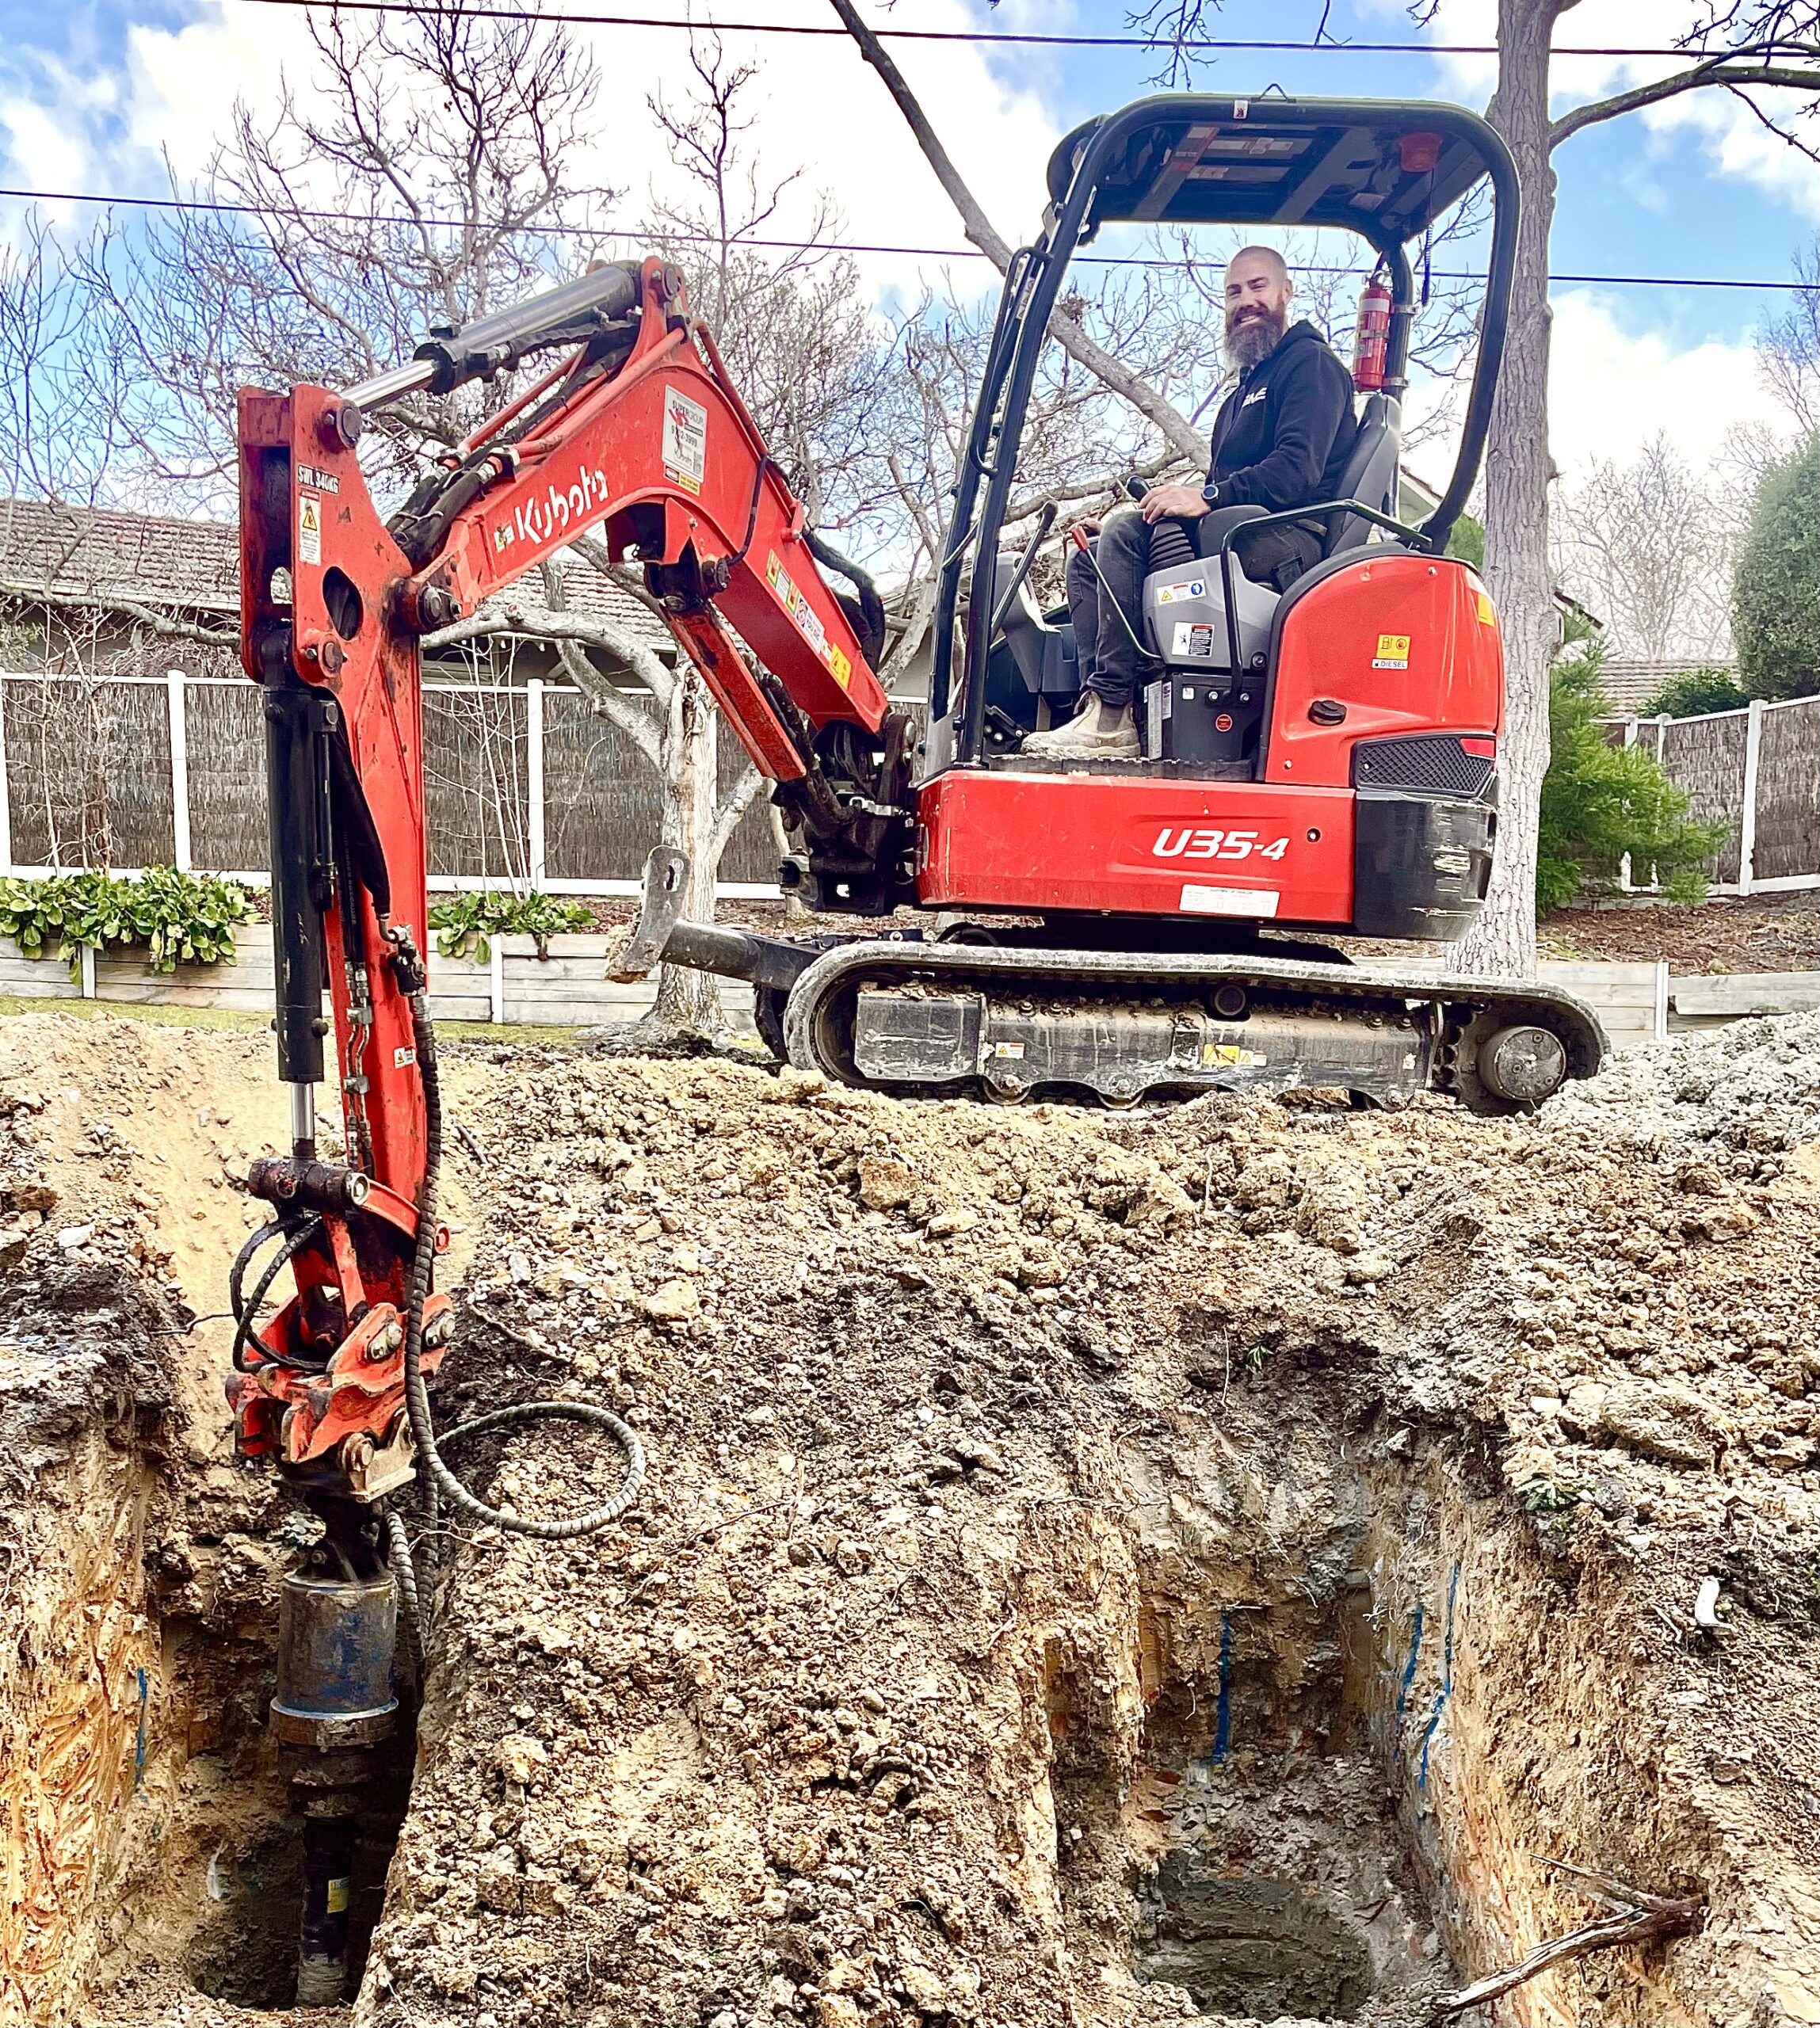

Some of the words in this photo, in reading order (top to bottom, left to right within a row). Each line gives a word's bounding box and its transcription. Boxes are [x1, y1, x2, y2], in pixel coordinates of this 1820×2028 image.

[298, 465, 315, 486] SWL
[514, 465, 609, 544] Kubota
[1152, 828, 1290, 861] U35-4
